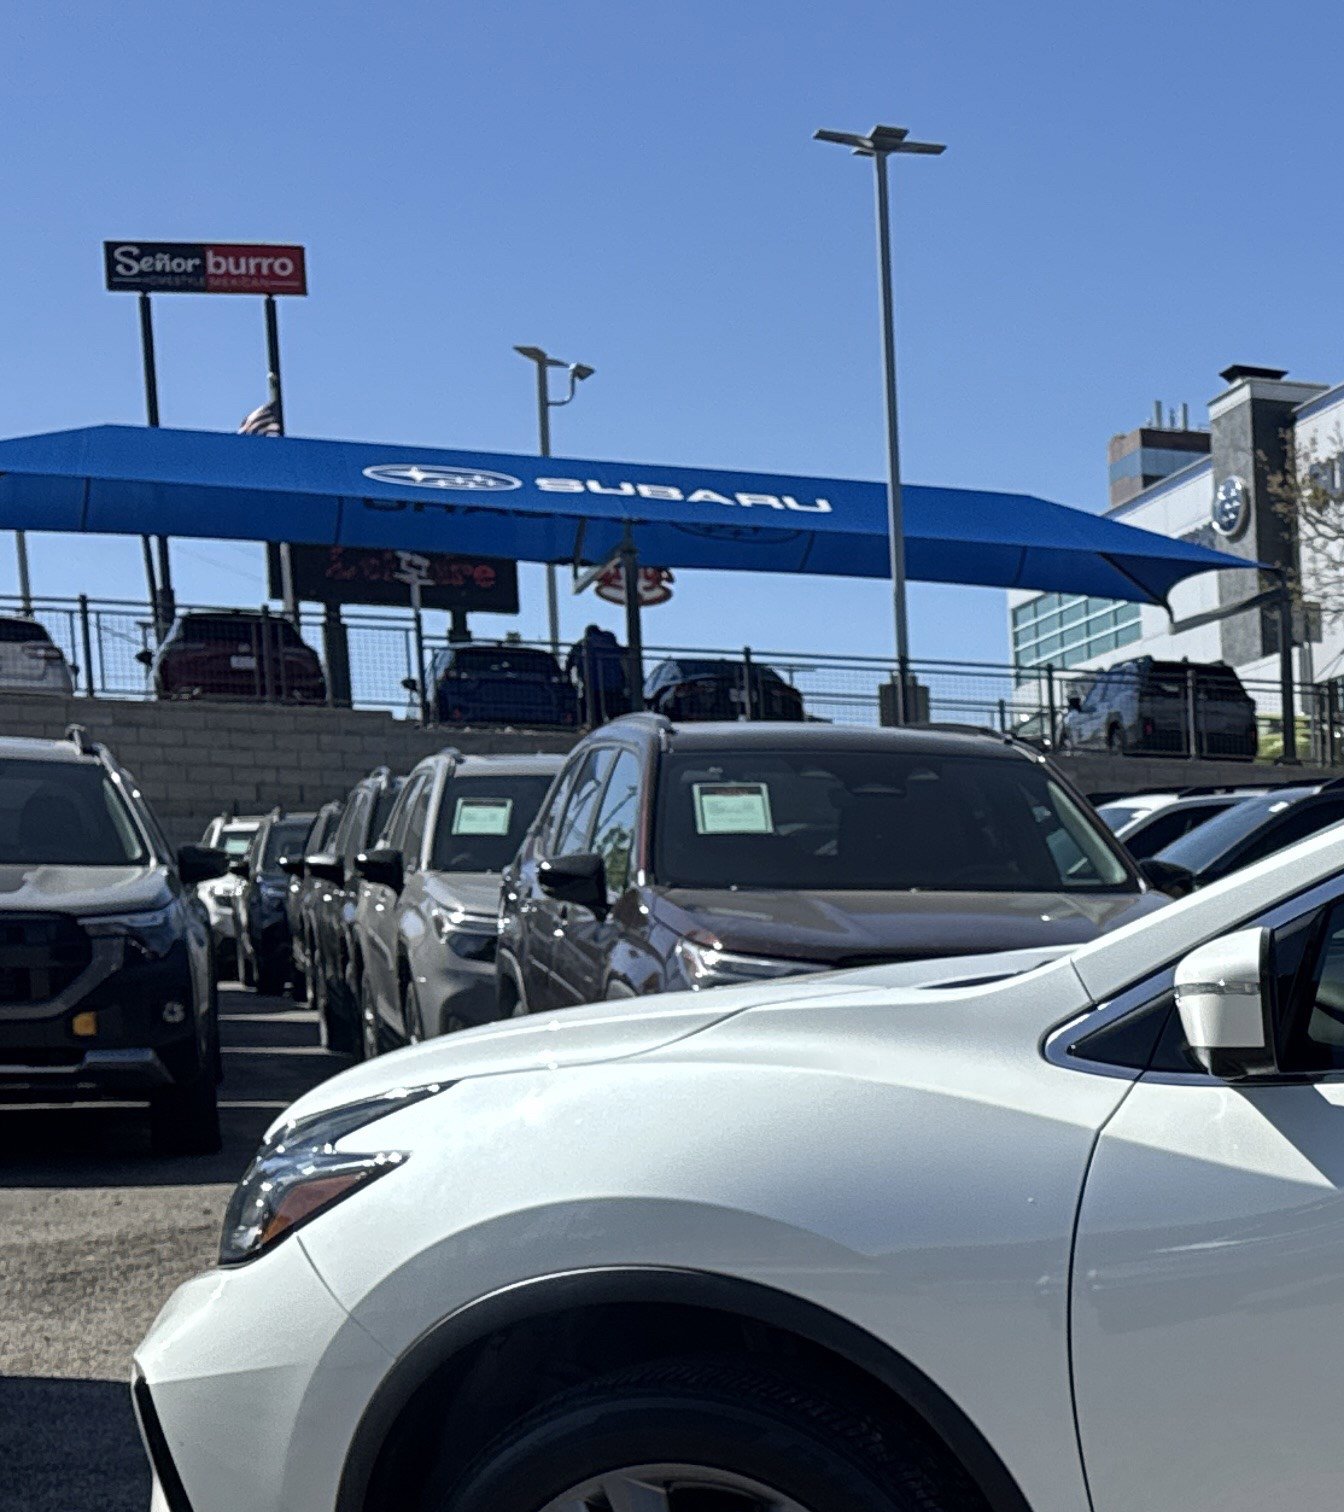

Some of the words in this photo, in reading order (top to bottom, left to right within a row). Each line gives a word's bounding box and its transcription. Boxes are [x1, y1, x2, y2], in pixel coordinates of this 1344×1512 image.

[113, 245, 200, 276] Señor
[206, 250, 294, 276] burro
[534, 476, 833, 513] SUBARU
